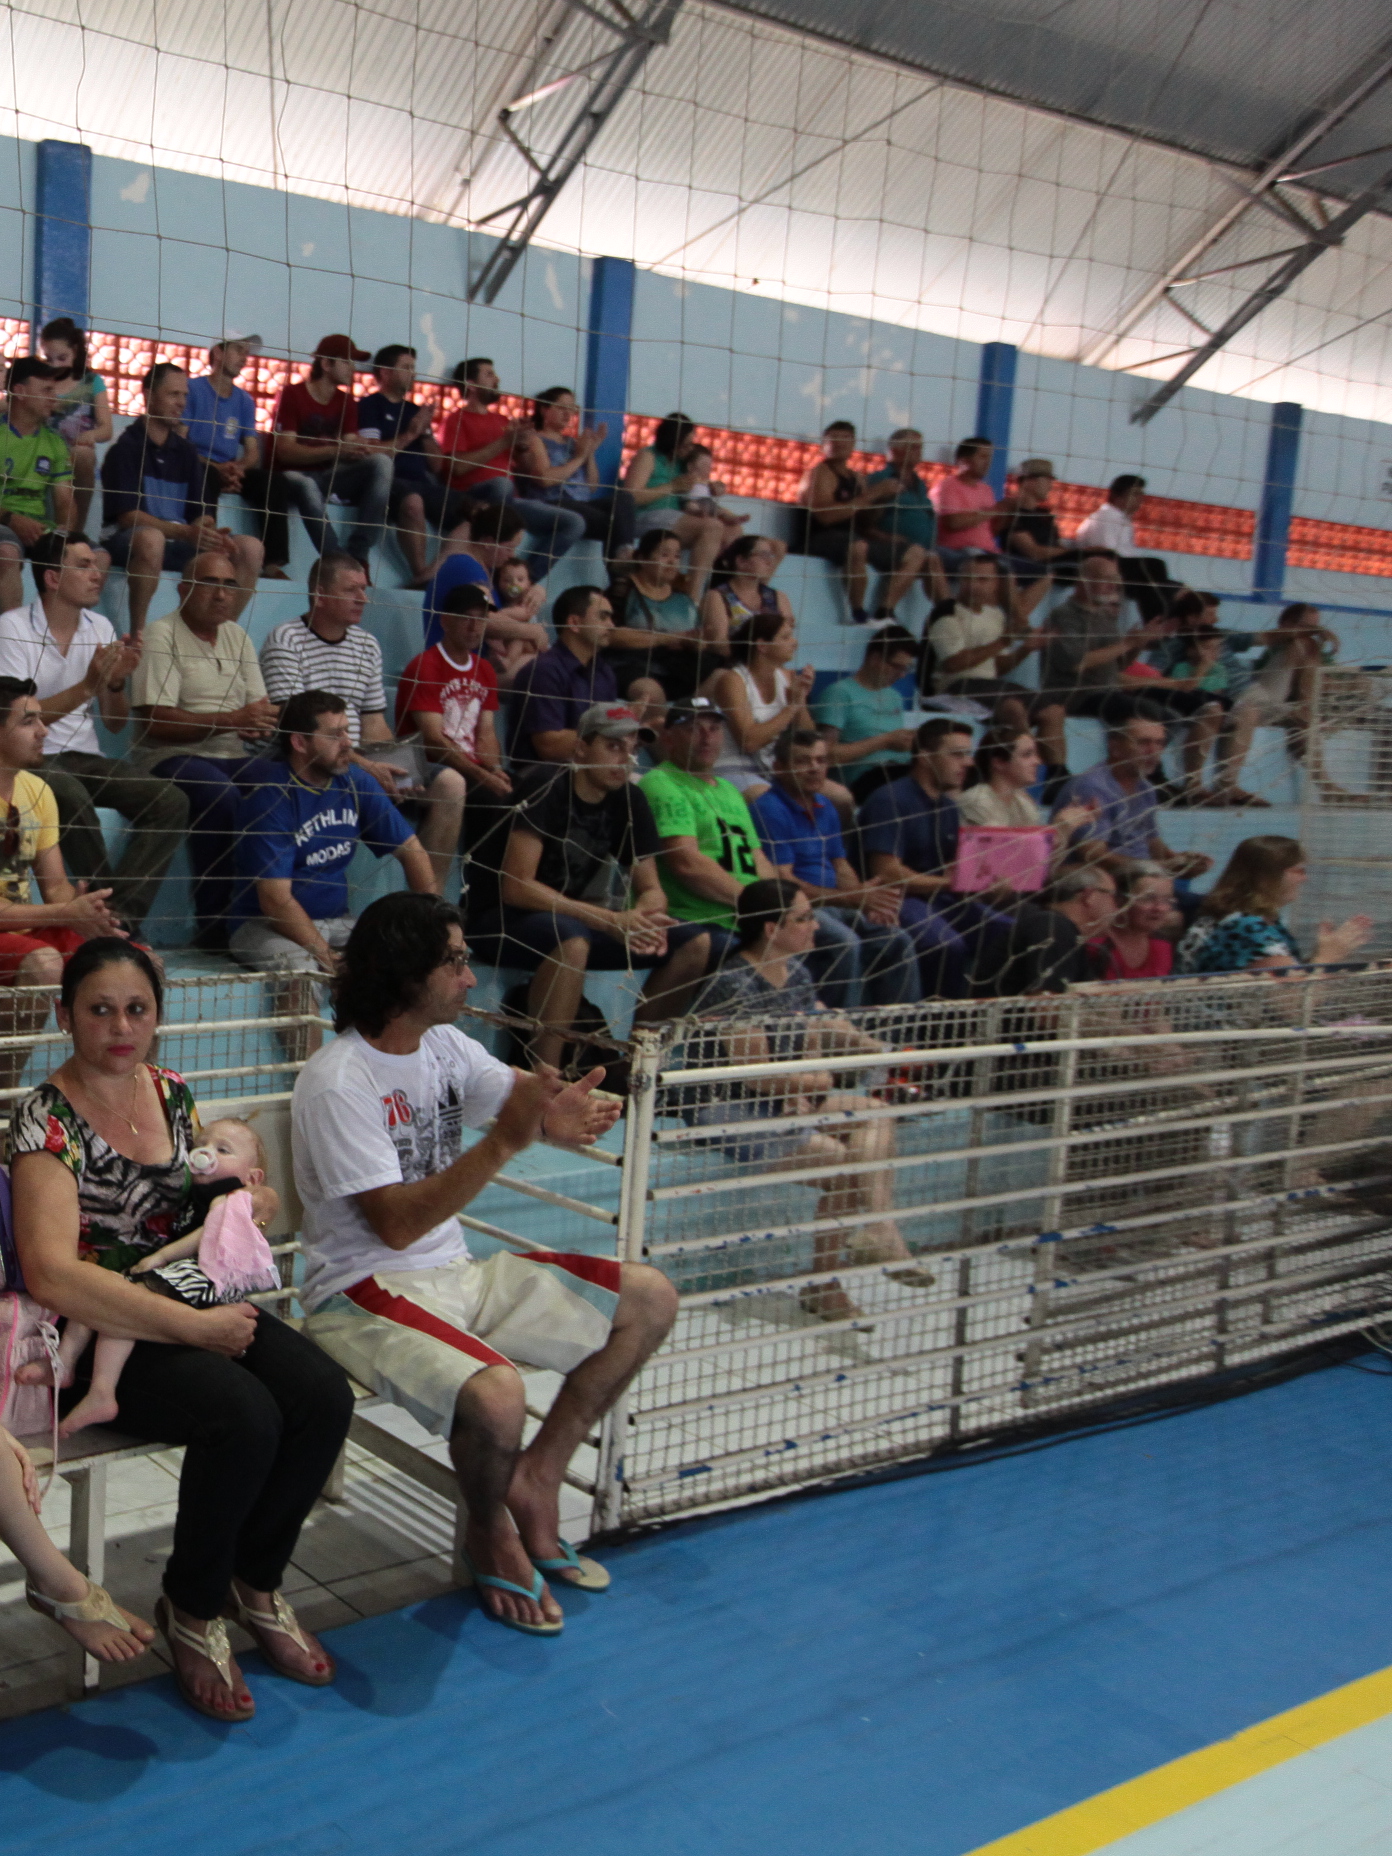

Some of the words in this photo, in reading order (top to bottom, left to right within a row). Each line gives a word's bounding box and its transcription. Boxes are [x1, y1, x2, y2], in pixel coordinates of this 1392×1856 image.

[295, 808, 359, 847] KETHLIN
[716, 816, 758, 878] 12
[306, 841, 352, 866] MODAS
